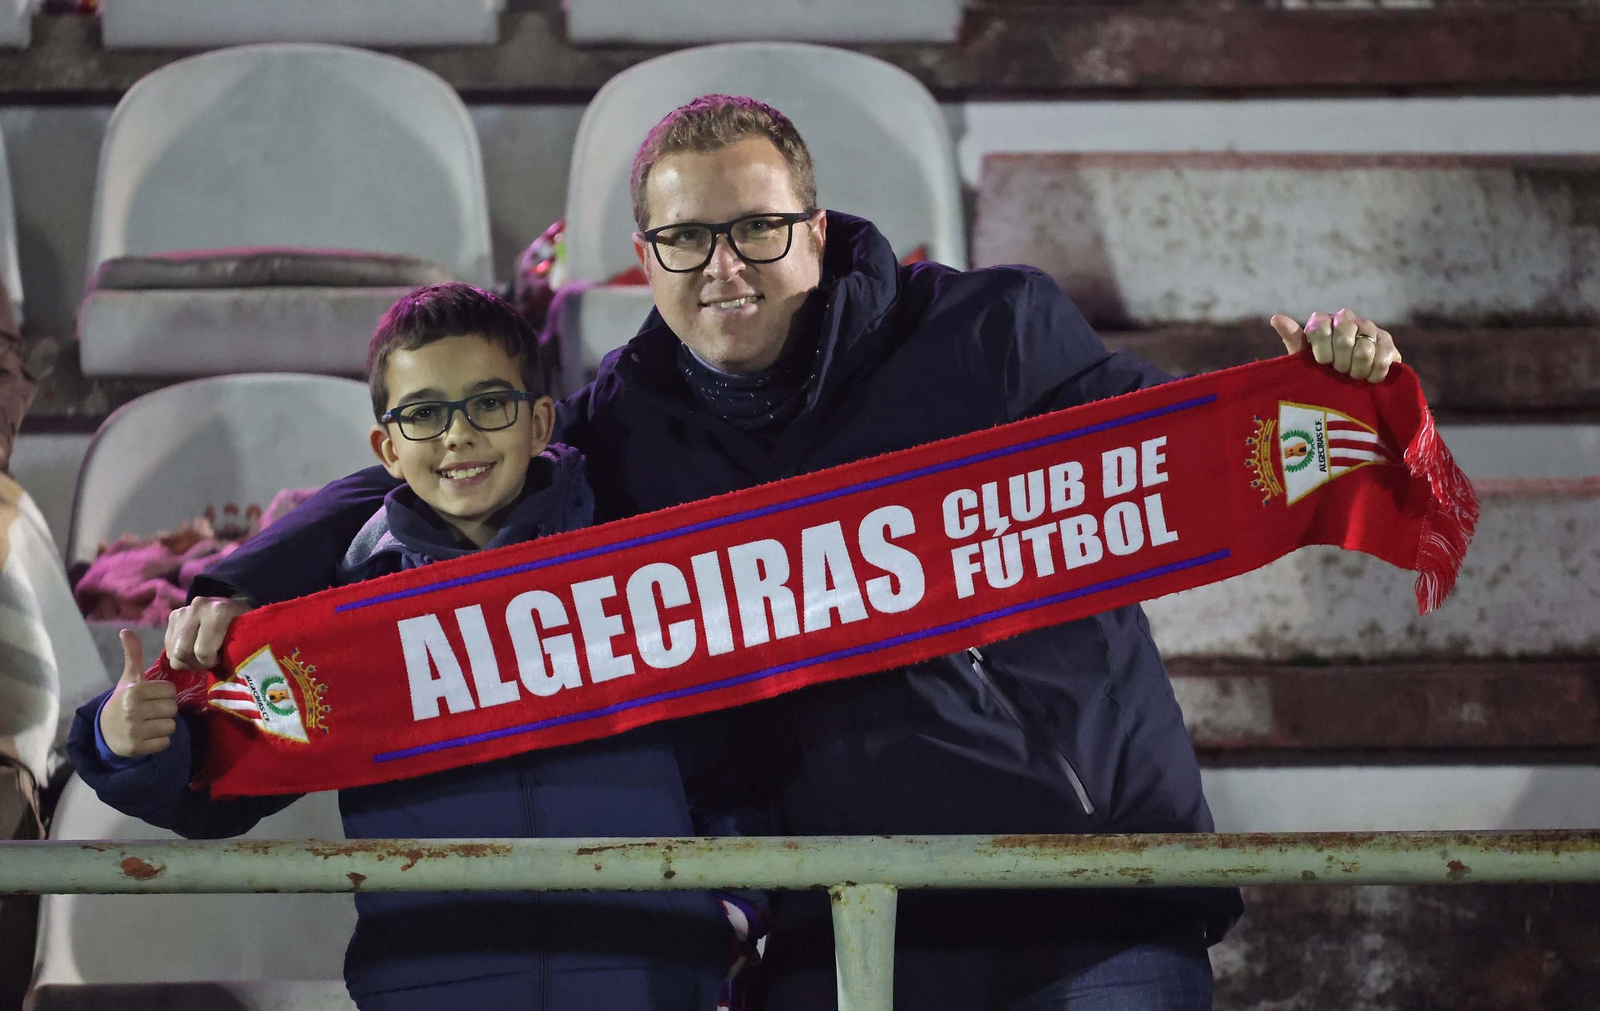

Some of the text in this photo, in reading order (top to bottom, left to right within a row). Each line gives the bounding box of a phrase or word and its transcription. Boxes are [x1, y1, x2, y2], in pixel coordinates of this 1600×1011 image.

[942, 435, 1169, 540] CLUB DE
[951, 493, 1179, 600] FÚTBOL
[397, 505, 926, 722] ALGECIRAS
